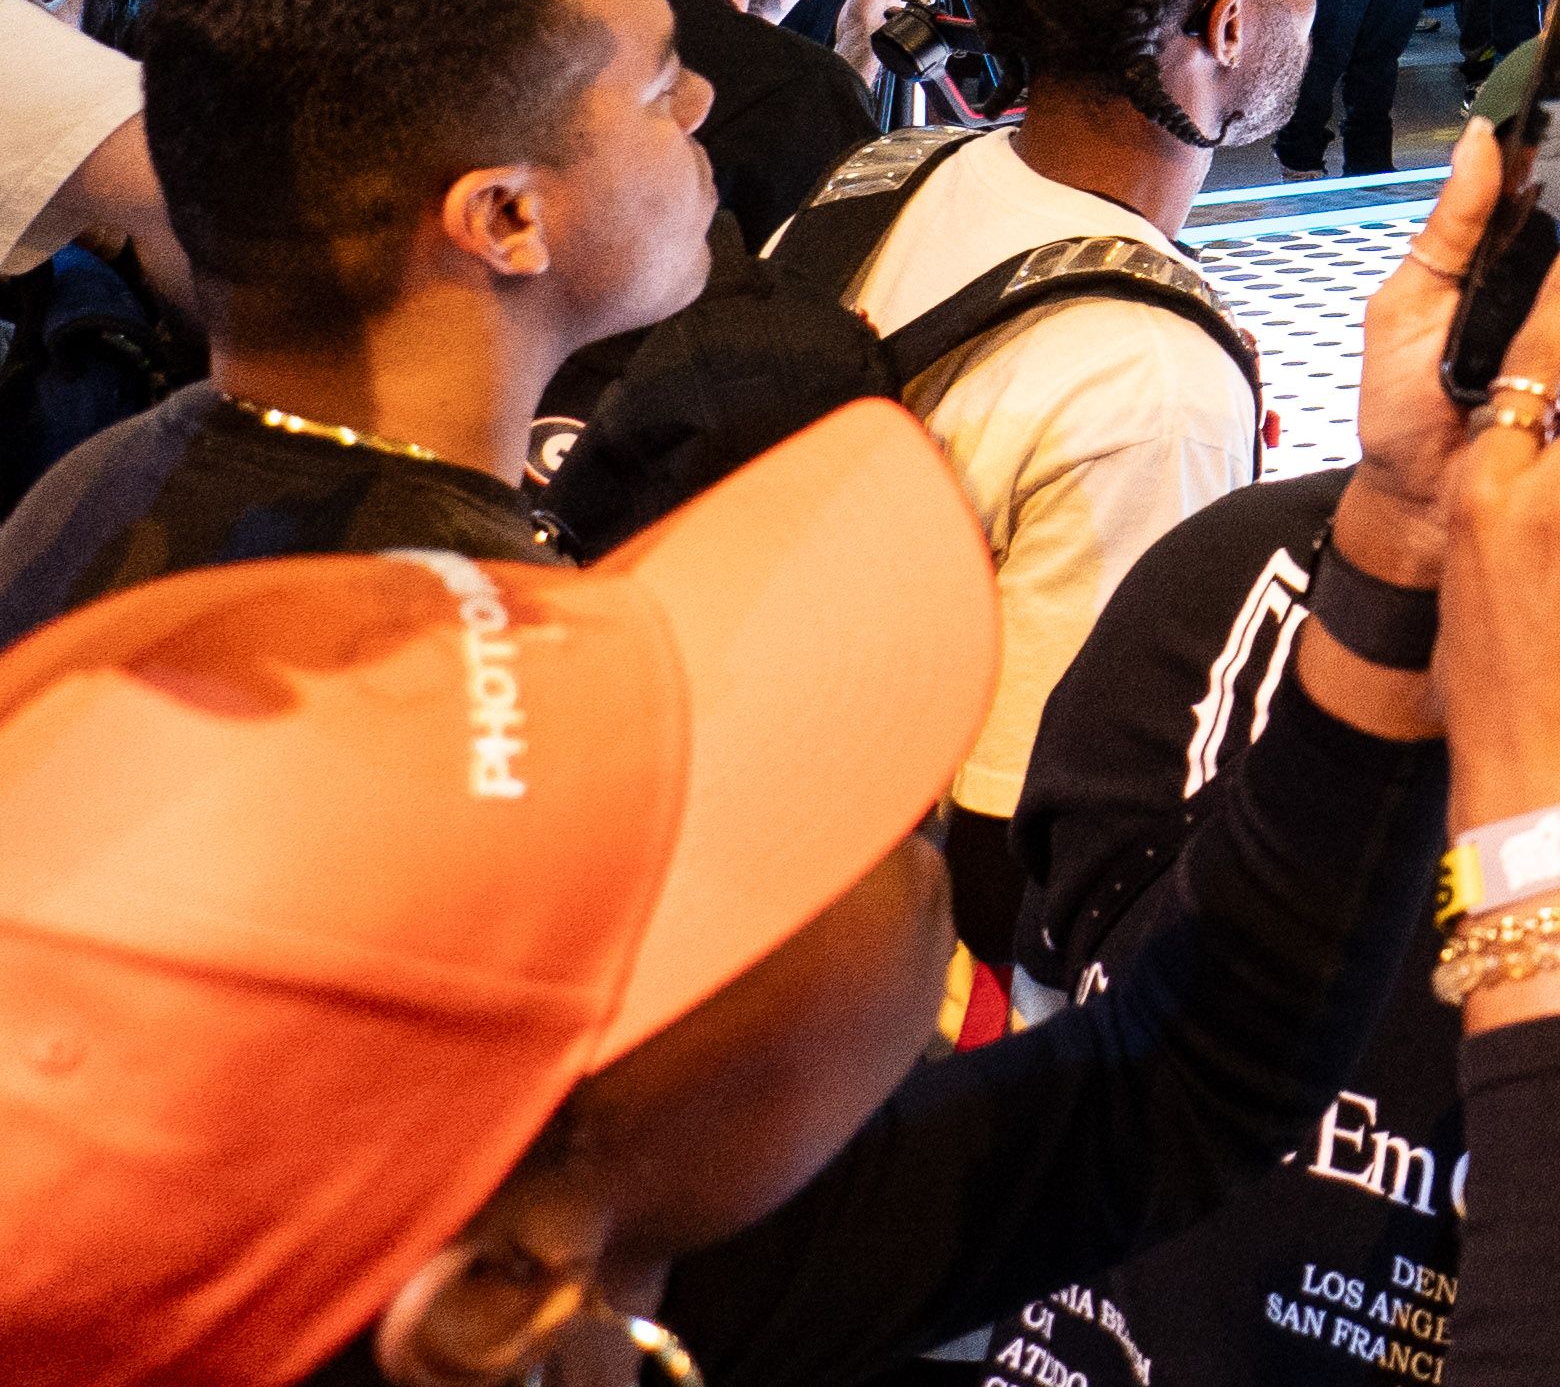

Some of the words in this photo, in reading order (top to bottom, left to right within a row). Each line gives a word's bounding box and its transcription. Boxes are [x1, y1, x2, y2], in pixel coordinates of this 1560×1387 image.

[1301, 1263, 1366, 1310] LOS
[1391, 1255, 1459, 1306] DEN
[1266, 1292, 1327, 1339] SAN
[1331, 1316, 1446, 1385] FRANCI
